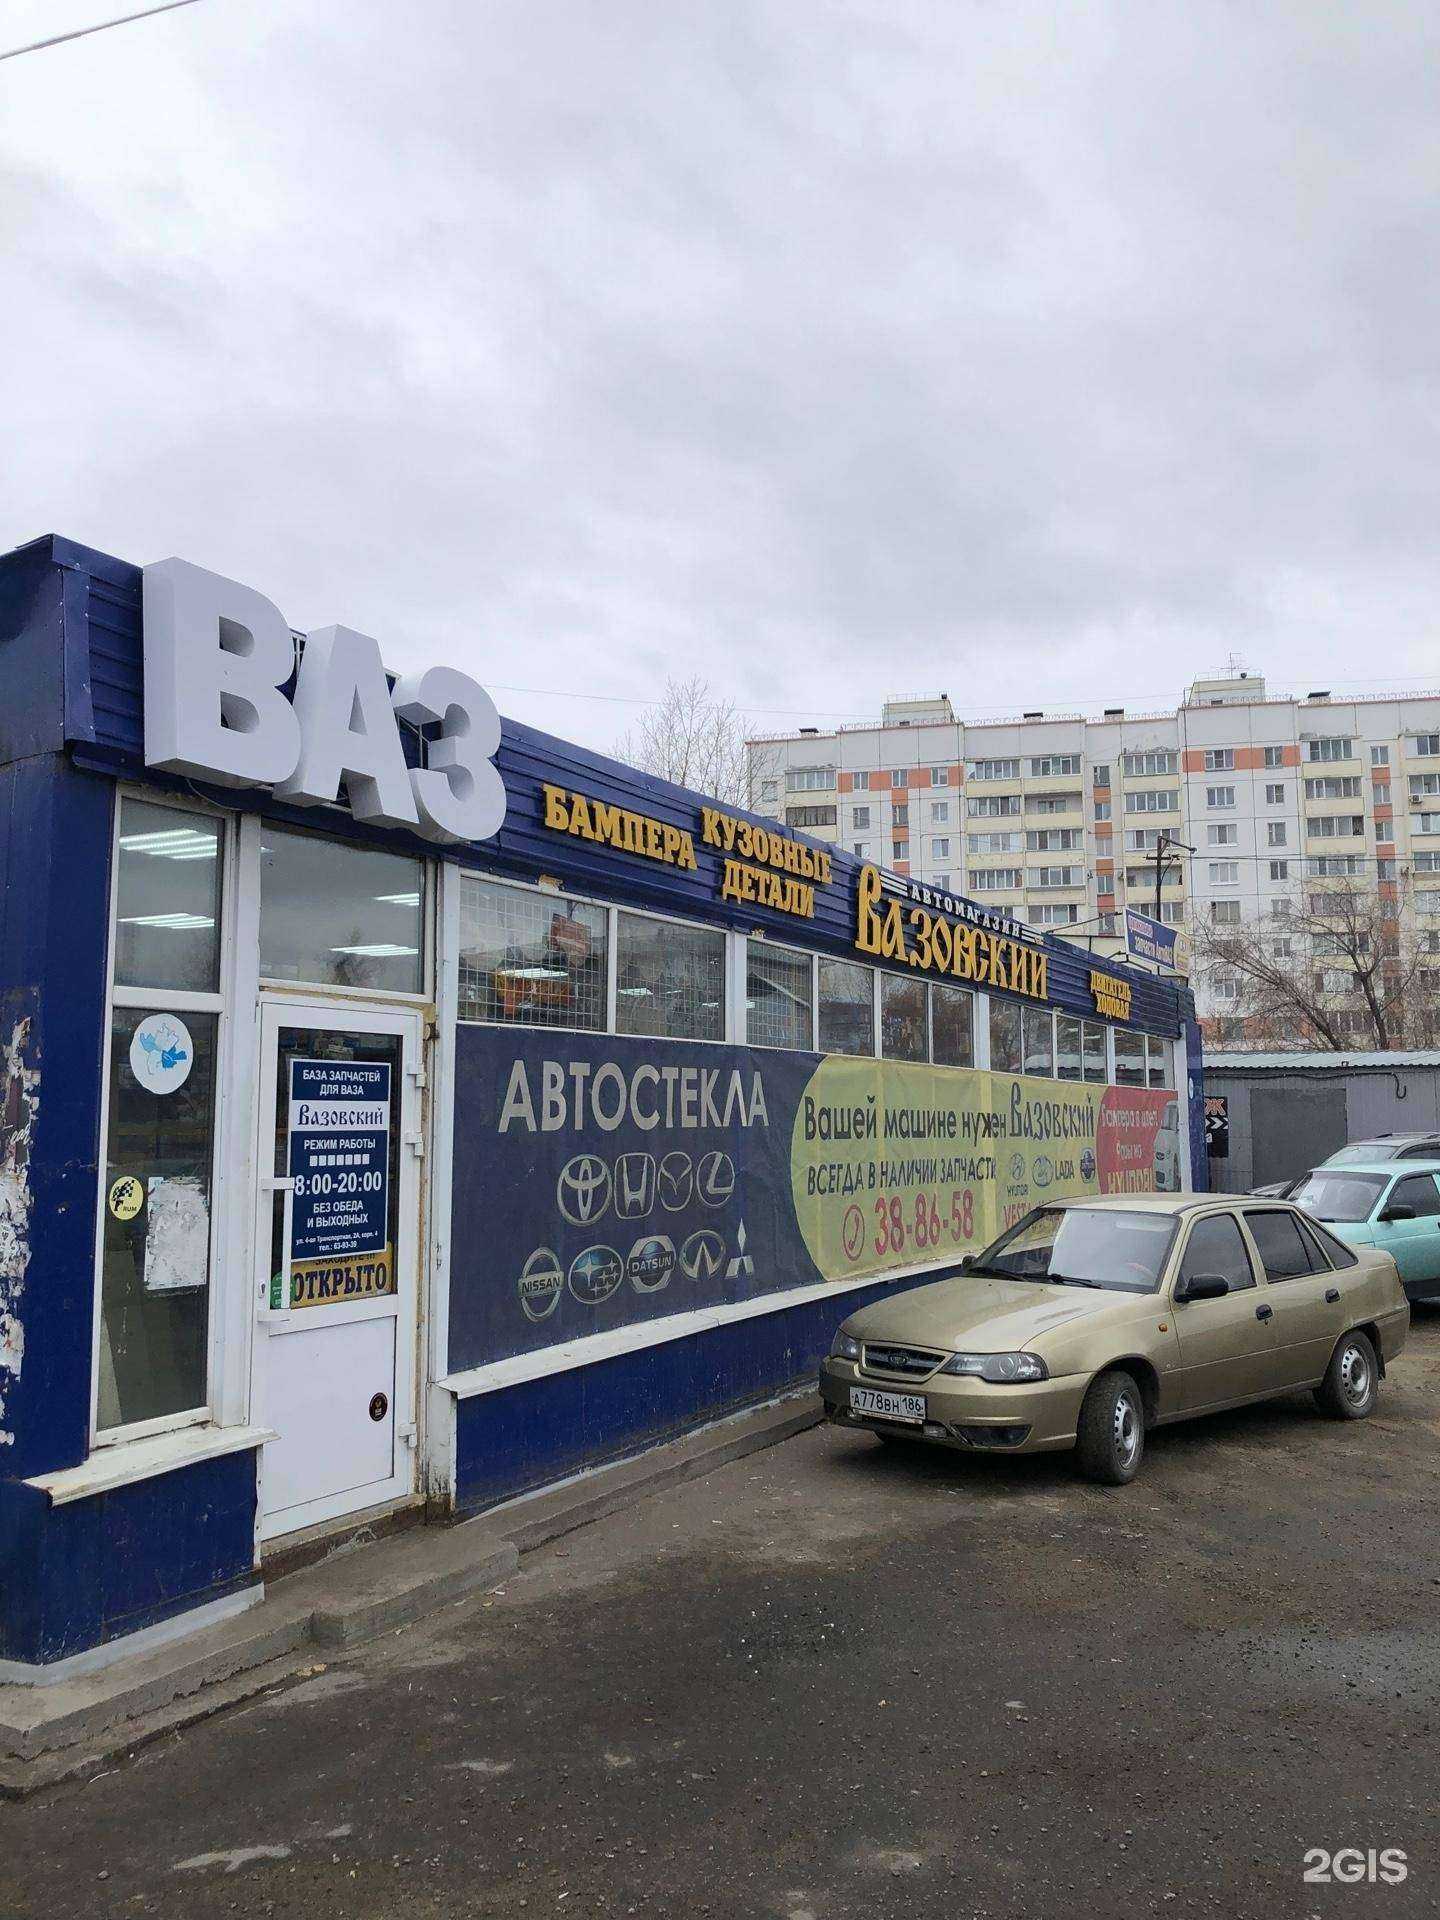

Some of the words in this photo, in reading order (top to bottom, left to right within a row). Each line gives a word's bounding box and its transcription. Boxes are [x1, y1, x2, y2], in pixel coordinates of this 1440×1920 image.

[143, 556, 507, 844] ВАЗ
[542, 783, 698, 870] БАМПЕРА
[701, 806, 833, 884] КУЗОВНЫЕ
[722, 858, 815, 919] ДЕТАЛИ
[911, 884, 1021, 936] АВТОМАГАЗИН
[303, 1069, 327, 1080] БАЗА
[329, 1070, 380, 1082] ЗАПЧАСТЕЙ
[320, 1084, 339, 1096] ДЛЯ
[341, 1084, 364, 1095] ВАЗА
[498, 1059, 769, 1133] АВТОСТЕКЛА
[804, 1095, 877, 1140] Вашей
[884, 1108, 956, 1139] машине
[962, 1111, 1007, 1147] нужен
[1009, 1081, 1094, 1141] Вазовский
[304, 1139, 338, 1150] РЕЖИМ
[339, 1138, 376, 1149] РАБОТЫ
[295, 1171, 382, 1195] 8:00-20:00
[808, 1161, 864, 1196] ВСЕГДА
[868, 1161, 876, 1189] В
[880, 1159, 937, 1188] НАЛИЧИИ
[940, 1156, 997, 1185] ЗАПЧАСТИ
[1054, 1159, 1075, 1181] LADA
[307, 1217, 314, 1228] И
[316, 1213, 369, 1228] ВЫХОДНЫХ
[313, 1202, 331, 1214] БЕЗ
[333, 1200, 364, 1213] ОБЕДА
[874, 1188, 974, 1256] 38-86-58
[631, 1256, 672, 1273] DATSUN
[292, 1262, 387, 1302] ОТКРЫТО
[521, 1275, 561, 1293] NISSAN
[853, 1390, 899, 1414] А778ВН
[902, 1396, 921, 1412] 186
